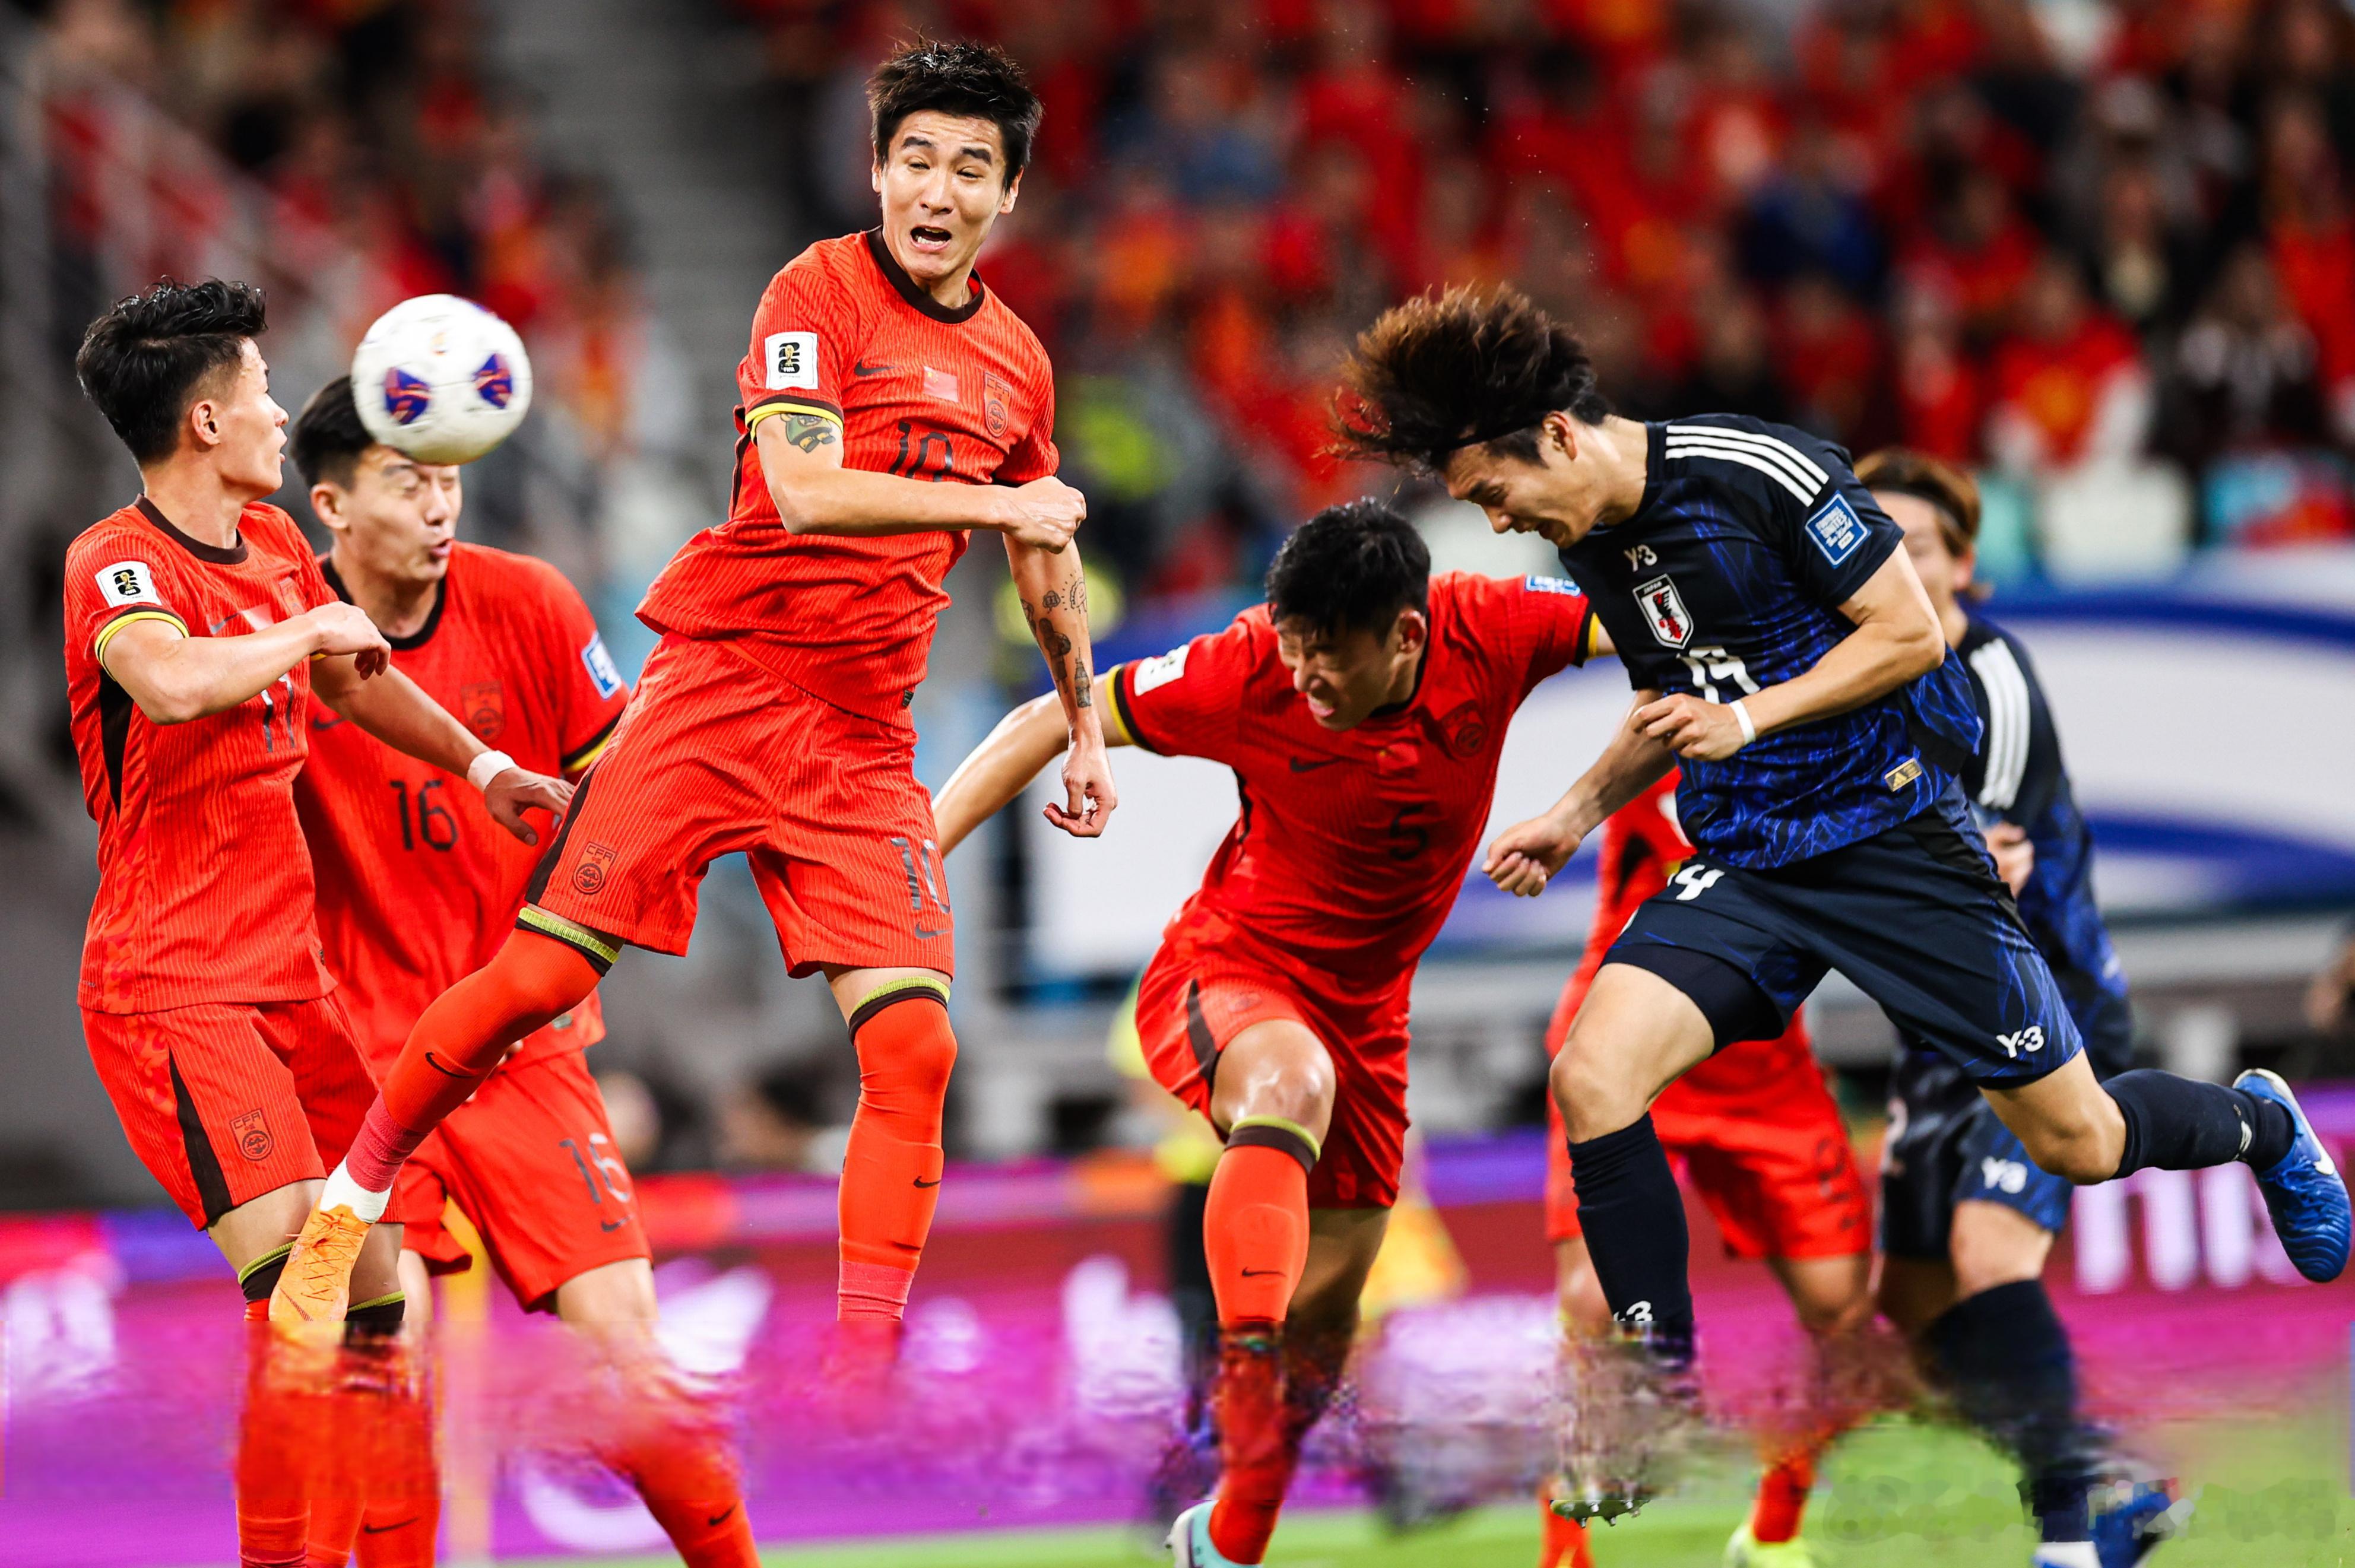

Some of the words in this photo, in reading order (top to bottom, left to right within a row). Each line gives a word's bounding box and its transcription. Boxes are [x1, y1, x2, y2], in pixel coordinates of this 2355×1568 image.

[389, 779, 459, 851] 16
[1390, 804, 1428, 861] 5
[587, 845, 613, 862] CFA
[1996, 1026, 2045, 1058] Y-3
[233, 1112, 261, 1129] CFA
[559, 1132, 630, 1204] 16
